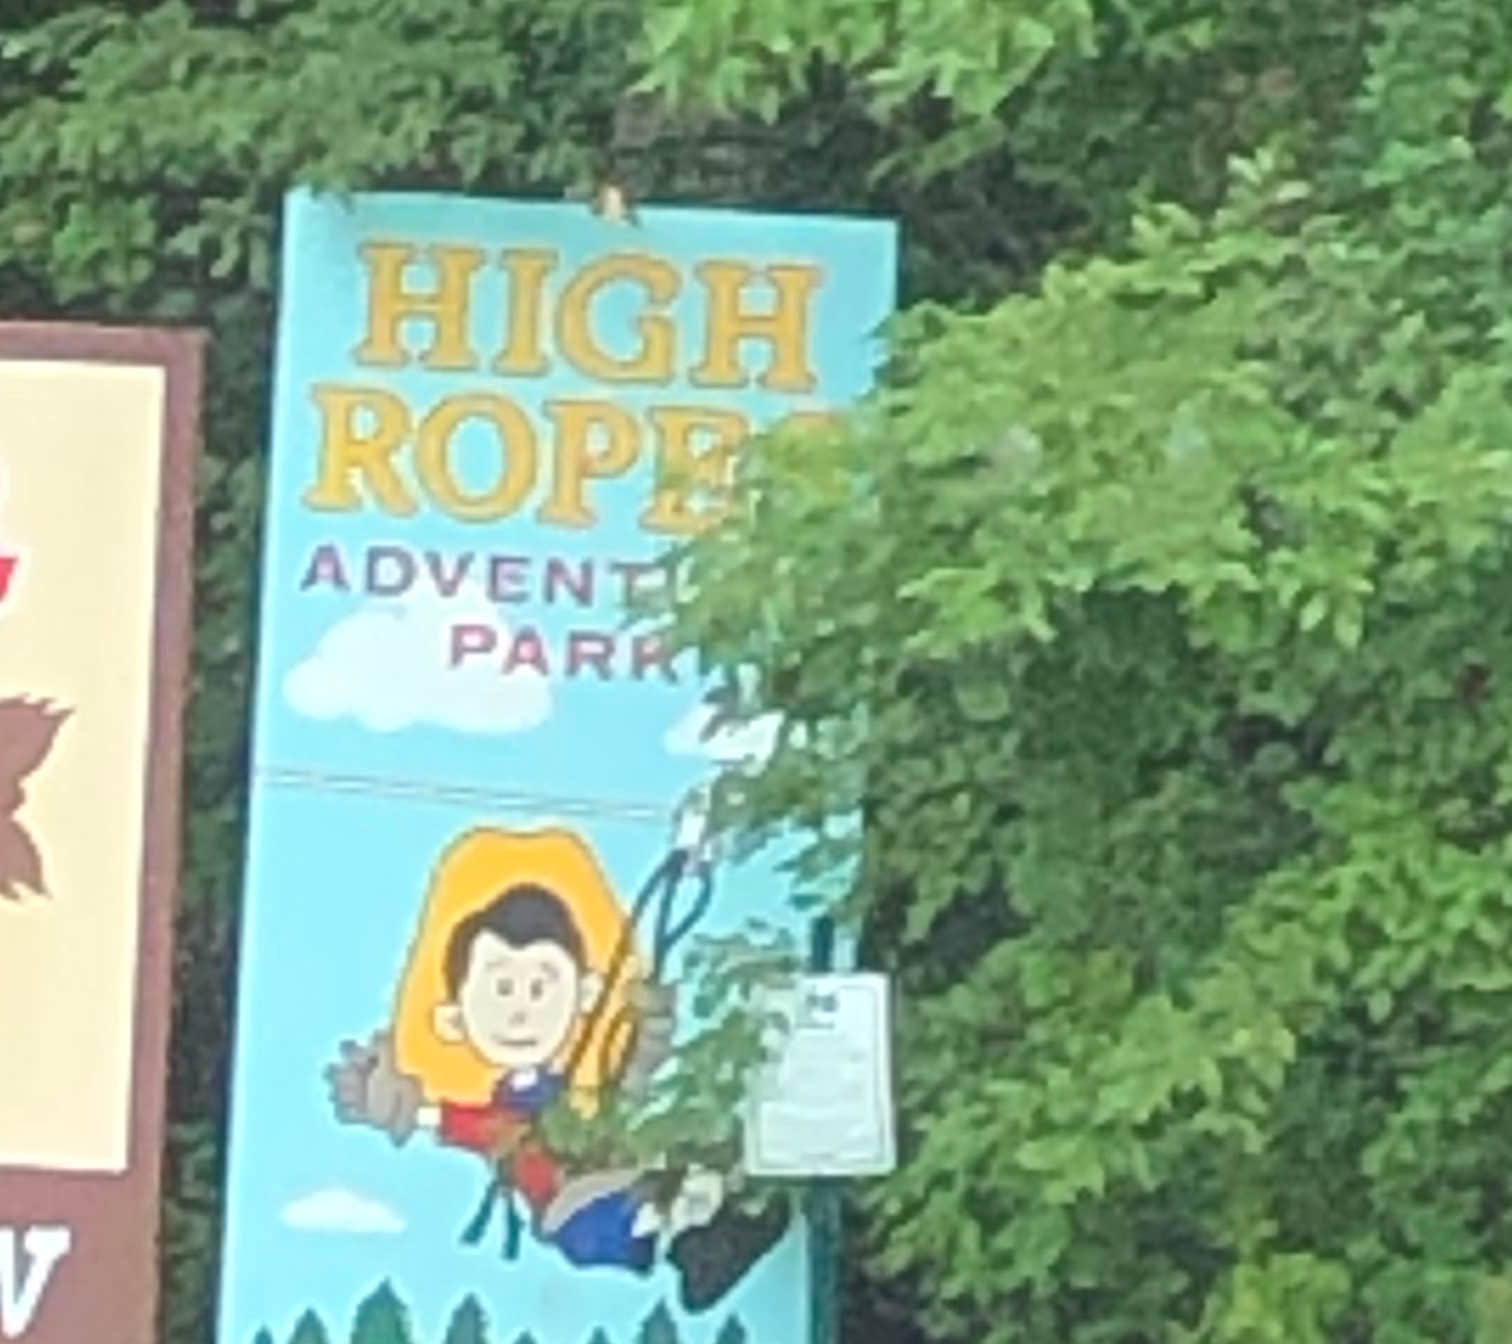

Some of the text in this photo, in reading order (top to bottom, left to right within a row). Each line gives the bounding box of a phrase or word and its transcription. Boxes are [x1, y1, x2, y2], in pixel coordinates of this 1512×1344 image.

[354, 240, 824, 393] HIGH
[300, 382, 850, 536] ROPE
[447, 622, 680, 684] PARK
